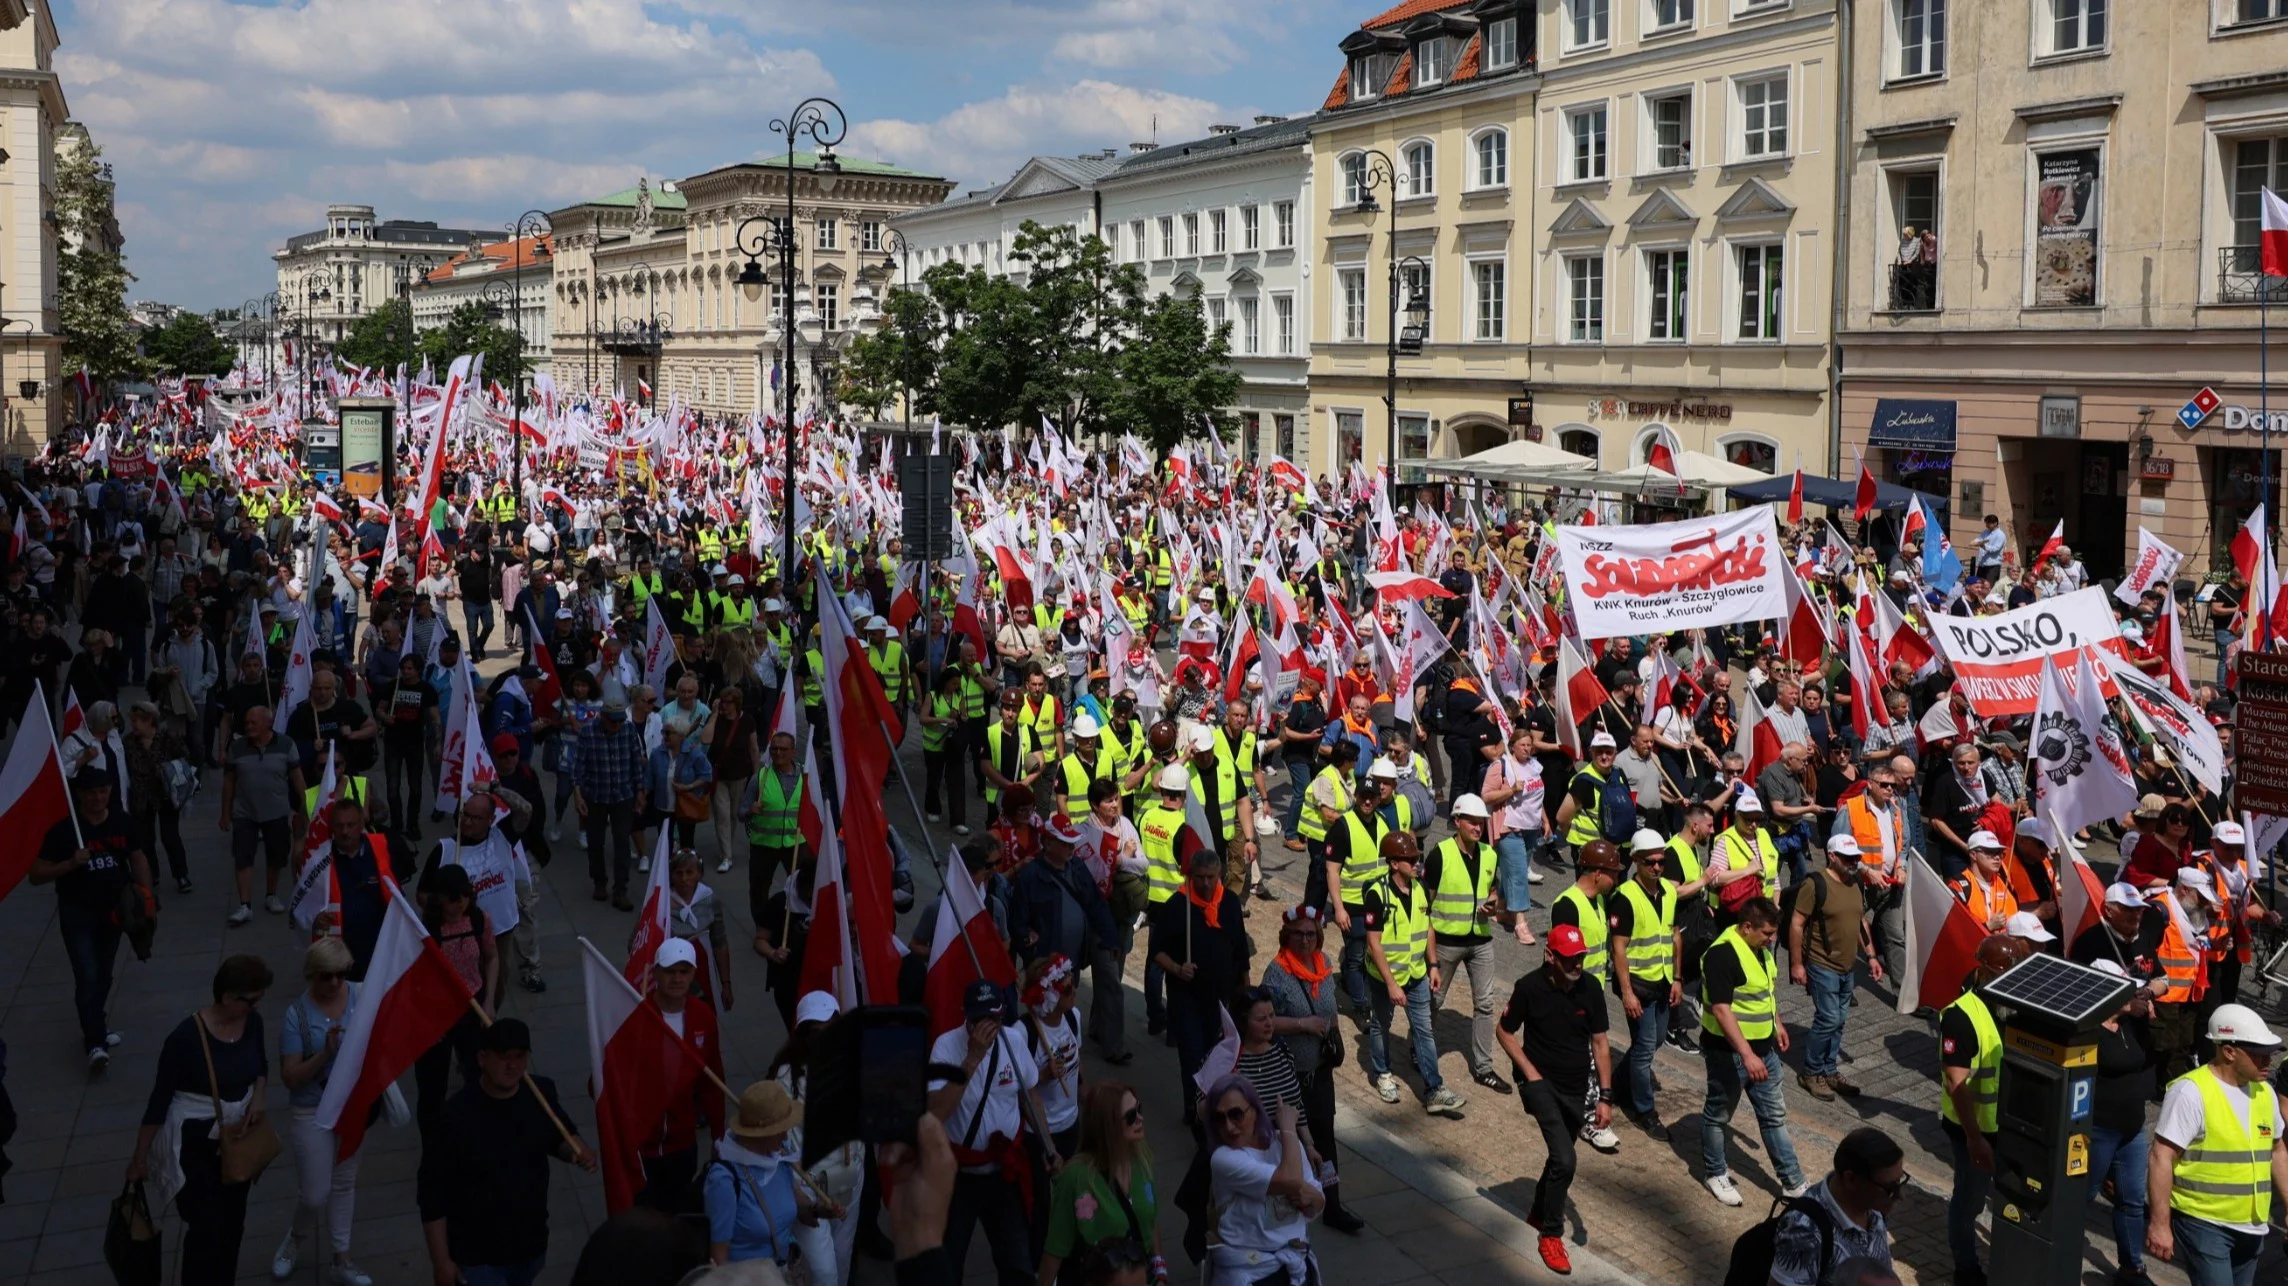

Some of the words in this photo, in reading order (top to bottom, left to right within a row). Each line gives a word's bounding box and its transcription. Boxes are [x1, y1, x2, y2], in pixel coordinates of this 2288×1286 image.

[1684, 402, 1732, 419] NERO
[2143, 461, 2169, 475] 16/18
[1580, 541, 1613, 551] NSZZ
[1594, 600, 1622, 610] KWK
[1624, 597, 1671, 609] Knurów
[1682, 583, 1764, 603] Szczygłowice
[1629, 609, 1658, 621] Ruch
[1949, 612, 2077, 658] POLSKO,
[2243, 655, 2288, 677] Stare
[2243, 706, 2287, 720] Muzeum
[2243, 717, 2260, 729] The
[2060, 721, 2082, 747] SEKCJA
[2243, 743, 2260, 755] The
[2241, 796, 2279, 811] Akademia
[2073, 1080, 2089, 1113] P
